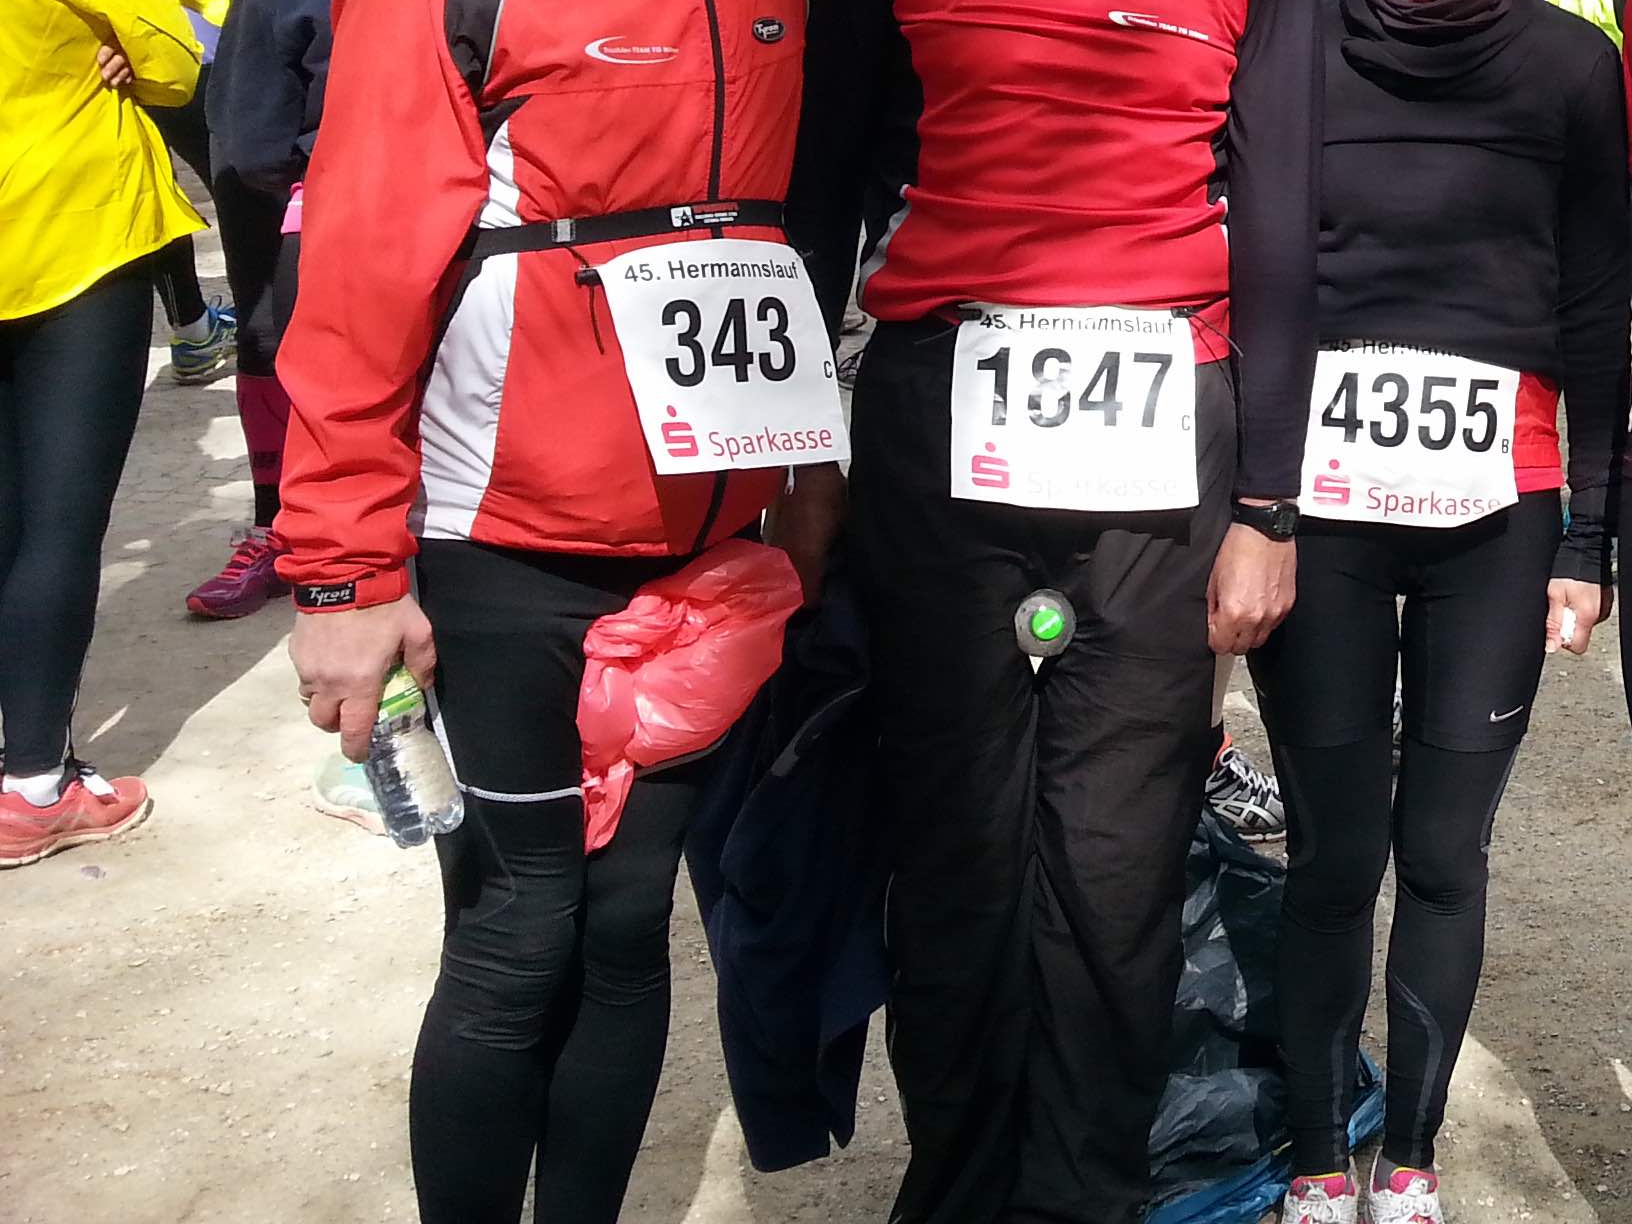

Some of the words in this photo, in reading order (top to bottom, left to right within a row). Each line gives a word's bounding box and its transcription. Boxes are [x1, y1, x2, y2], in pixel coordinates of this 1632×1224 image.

[624, 262, 661, 282] 45.
[667, 259, 799, 280] Hermannslauf
[661, 296, 796, 388] 343
[979, 313, 1011, 330] 45.
[1019, 313, 1175, 336] Hermannslauf
[976, 346, 1173, 428] 1847
[1321, 371, 1500, 453] 4355
[708, 426, 833, 462] Sparkasse
[1366, 486, 1501, 517] Sparkasse
